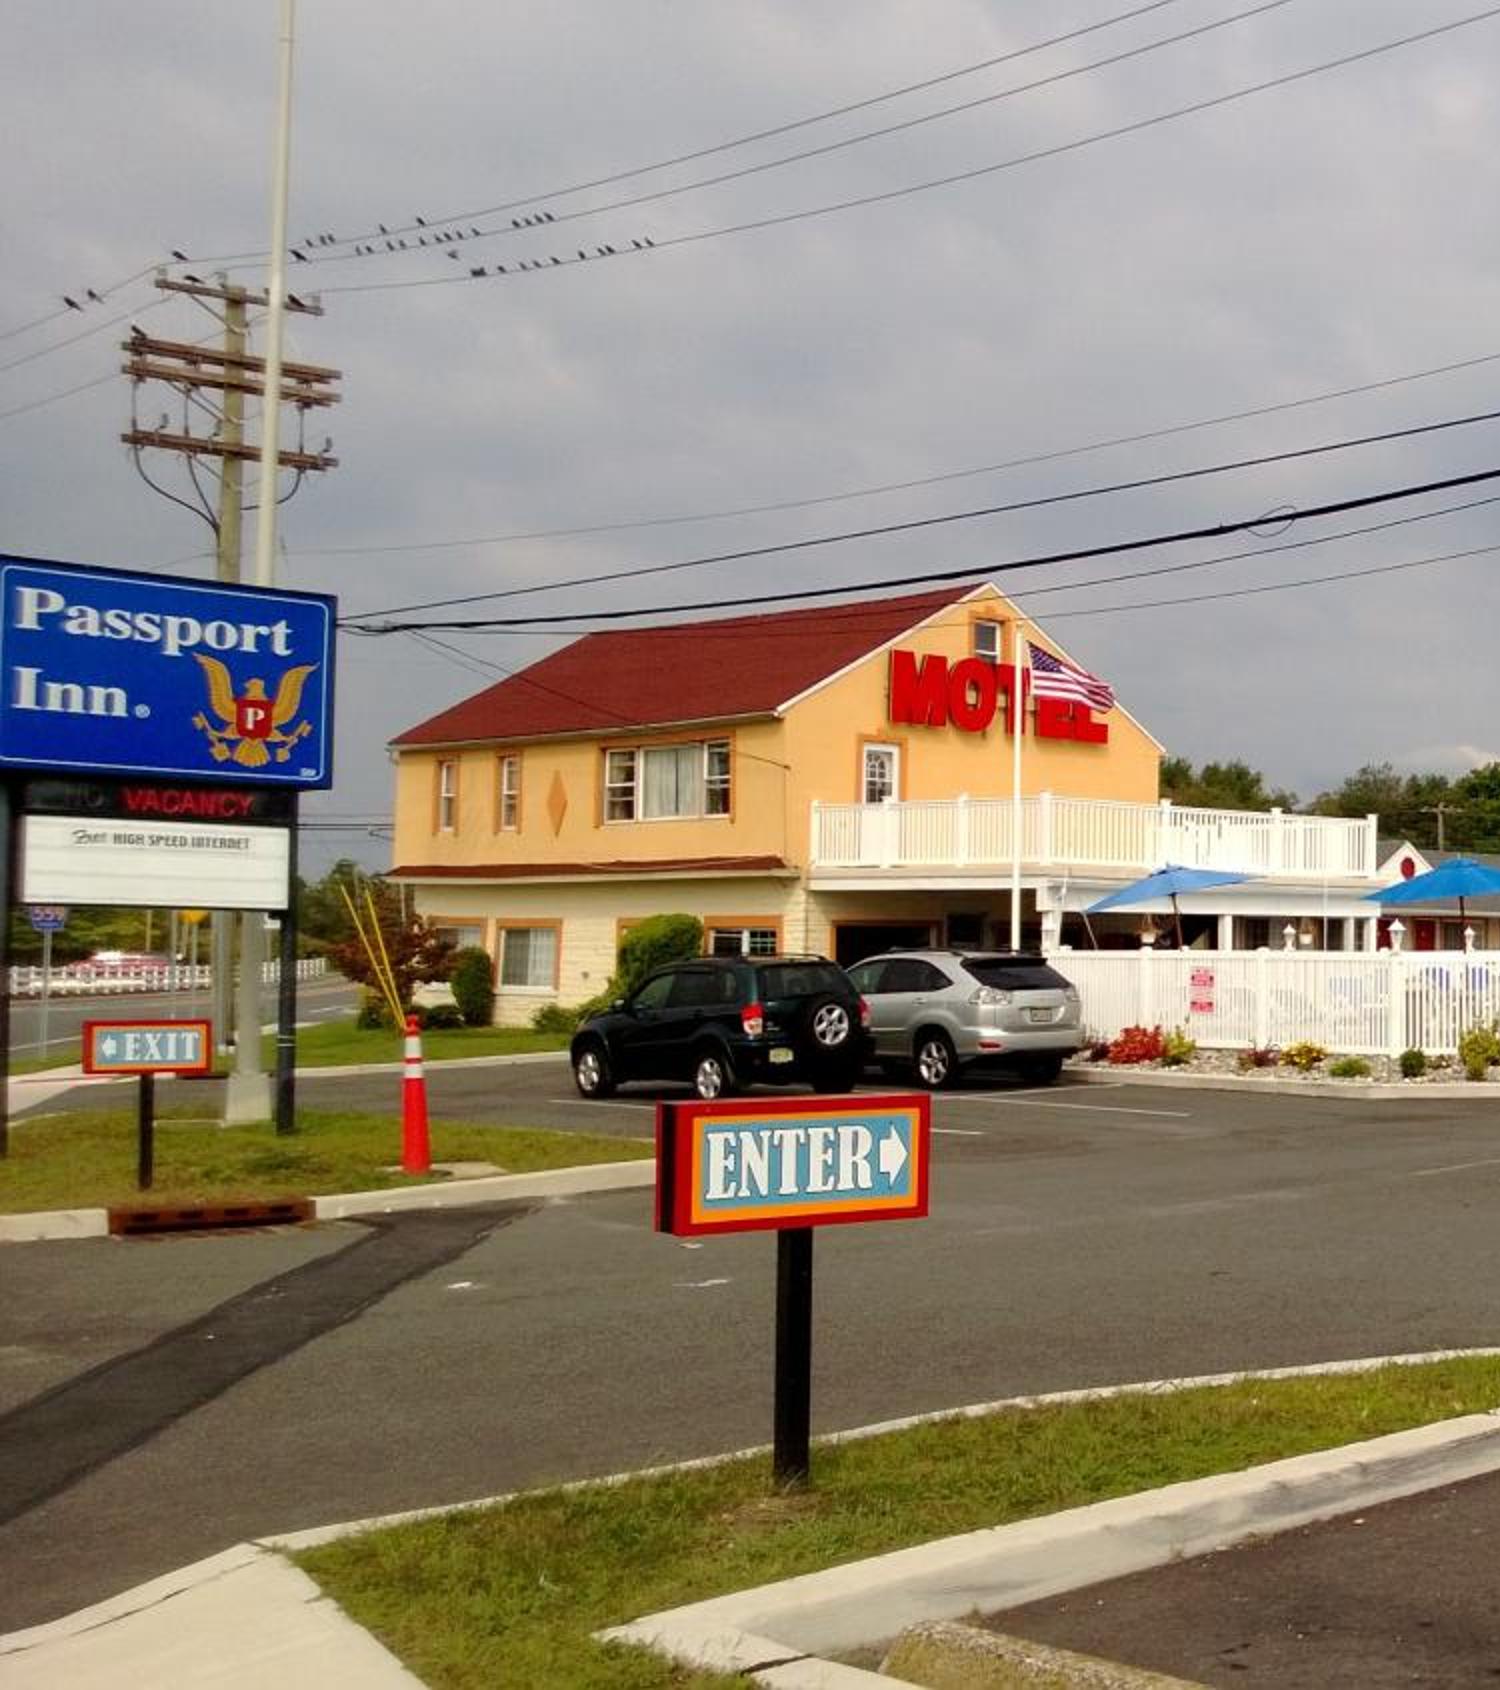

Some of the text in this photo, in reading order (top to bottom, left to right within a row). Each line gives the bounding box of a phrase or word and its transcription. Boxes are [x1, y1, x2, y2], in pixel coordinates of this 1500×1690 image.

[14, 586, 294, 657] Passport
[889, 649, 1109, 744] MOTEL
[245, 707, 265, 731] P
[124, 788, 256, 817] VACANCY
[113, 832, 144, 846] HIGH
[148, 834, 188, 848] SPEED
[191, 836, 250, 850] INTERNET
[125, 1031, 199, 1061] EXIT
[704, 1125, 873, 1200] ENTER
